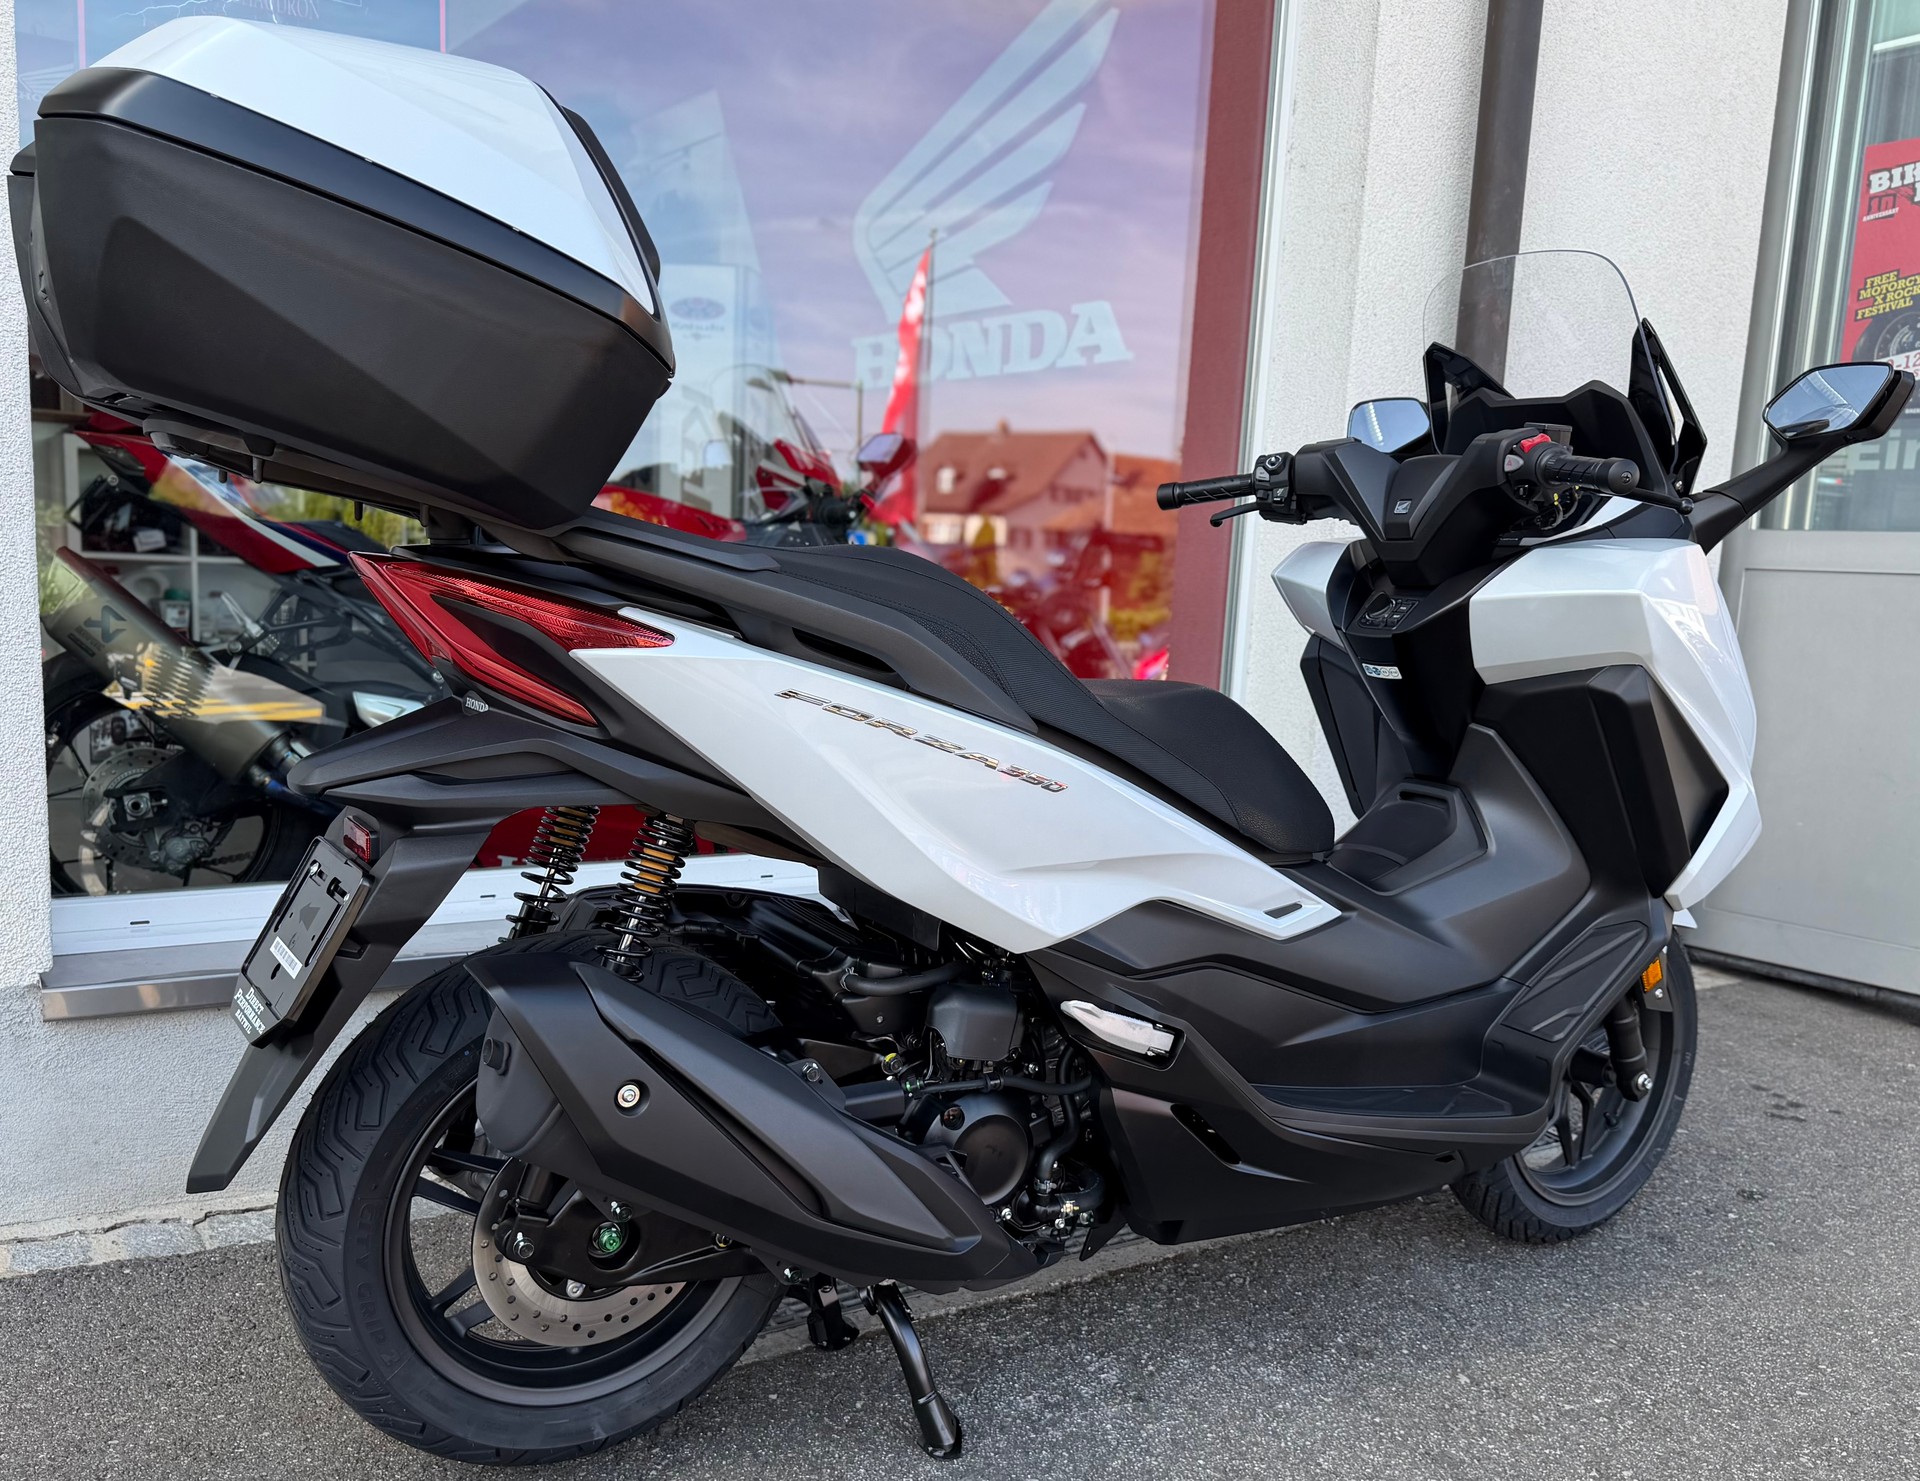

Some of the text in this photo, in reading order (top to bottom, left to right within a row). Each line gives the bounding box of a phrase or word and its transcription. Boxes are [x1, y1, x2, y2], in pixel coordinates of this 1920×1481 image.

[1866, 271, 1898, 289] FREE
[1874, 284, 1920, 305] X ROCK
[1856, 297, 1914, 319] FESTIVAL
[465, 697, 489, 712] HONDA
